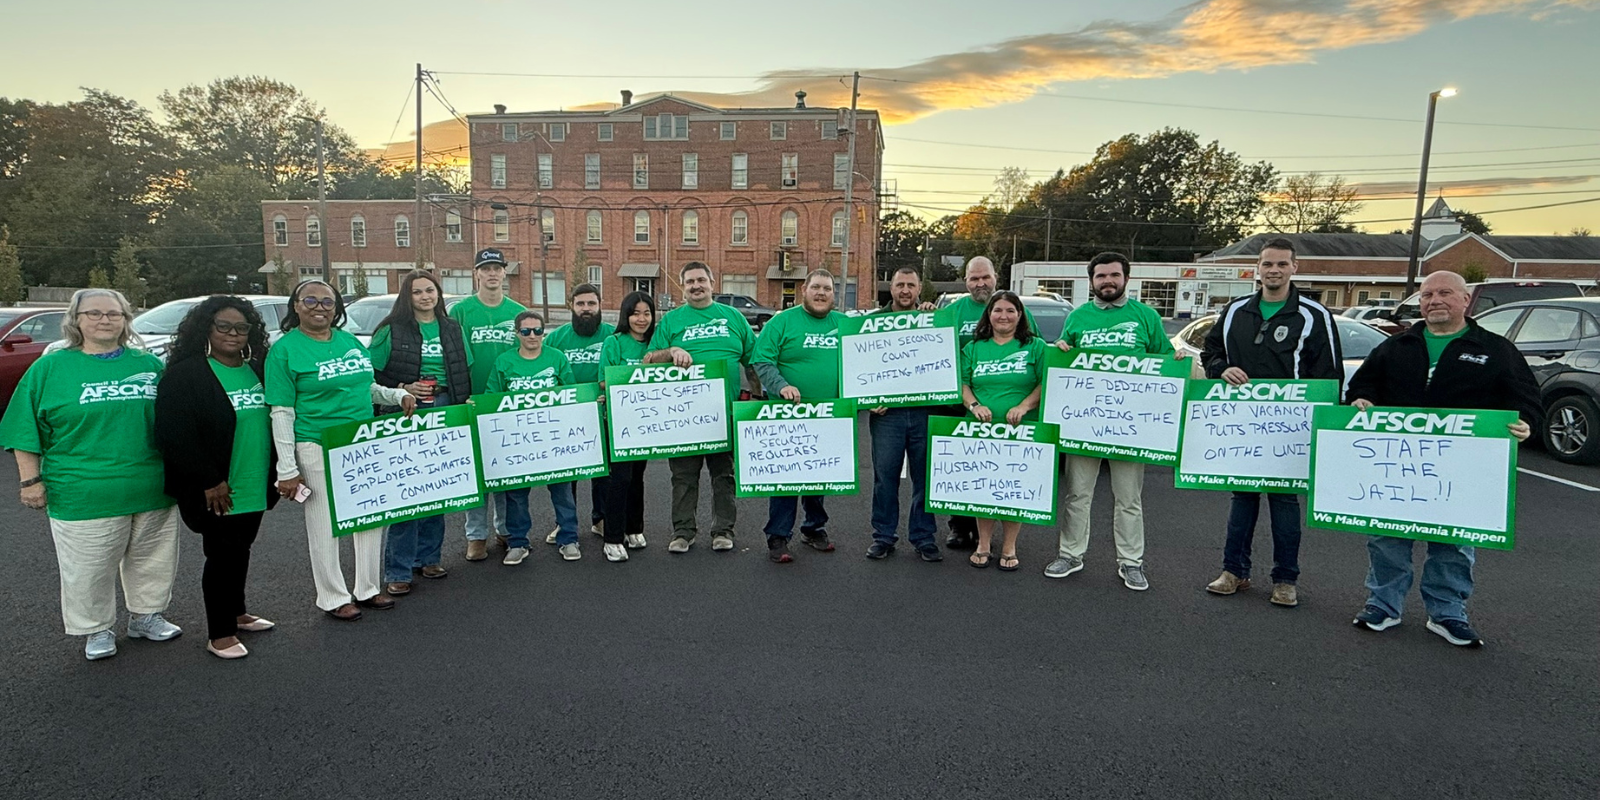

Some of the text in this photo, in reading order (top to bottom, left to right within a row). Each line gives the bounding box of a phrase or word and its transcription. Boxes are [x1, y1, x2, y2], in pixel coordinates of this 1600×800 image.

[683, 325, 729, 338] AFSCME
[859, 313, 934, 333] AFSCME
[471, 330, 516, 340] AFSCME
[854, 333, 943, 353] WHEN SECONDS
[1080, 332, 1137, 344] AFSCME
[882, 349, 918, 363] COUNT
[1070, 353, 1164, 374] AFSCME
[318, 358, 372, 377] AFSCME
[628, 364, 705, 383] AFSCME
[857, 359, 951, 385] STAFFING MATTERS
[974, 361, 1026, 373] AFSCME
[80, 384, 157, 400] AFSCME
[508, 377, 555, 390] AFSCME
[1059, 376, 1178, 394] THE DEDICATED
[1204, 383, 1307, 401] AFSCME
[497, 388, 577, 411] AFSCME
[617, 383, 711, 406] PUBLIC SAFETY
[880, 394, 926, 403] Pennsylvania
[1095, 395, 1124, 405] FEW
[635, 401, 693, 418] IS NOT
[756, 403, 834, 419] AFSCME
[1062, 406, 1174, 424] GUARDING THE
[1191, 403, 1309, 421] EVERY VACANCY
[352, 411, 446, 443] AFSCME
[490, 410, 560, 433] I FEEL
[621, 413, 719, 438] A SKELETON CREW
[952, 421, 1036, 440] AFSCME
[1205, 420, 1313, 436] PUTS PRESSUR
[1345, 411, 1476, 435] AFSCME
[502, 426, 586, 447] LIKE I AM
[744, 423, 807, 440] MAXIMUM
[1092, 425, 1137, 437] WALLS
[342, 430, 466, 468] MAKE THE JAIL
[492, 434, 597, 466] A SINGLE PARENT!
[630, 448, 649, 456] Make
[652, 444, 697, 454] Pennsylvania
[760, 434, 818, 448] SECURITY
[937, 440, 1043, 460] I WANT MY
[1352, 438, 1452, 458] STAFF
[748, 445, 818, 461] REQUIRES
[1082, 443, 1138, 456] Pennsylvania
[1139, 450, 1176, 461] Happen
[1205, 448, 1225, 460] ON
[1229, 445, 1263, 457] THE
[343, 445, 451, 482] SAFE FOR THE
[749, 457, 840, 476] MAXIMUM STAFF
[934, 461, 1028, 476] HUSBAND TO
[1374, 463, 1438, 478] THE
[485, 466, 604, 488] We Make Pennsylvania Happen
[935, 478, 1021, 493] MAKE IT HOME
[1180, 475, 1196, 483] We
[1199, 476, 1224, 484] Make
[1227, 477, 1289, 488] Pennsylvania
[357, 472, 470, 510] THE COMMUNITY
[740, 485, 753, 493] We
[776, 484, 823, 492] Pennsylvania
[338, 497, 479, 530] We Make Pennsylvania Happen
[944, 502, 965, 511] Make
[967, 505, 1017, 516] Pennsylvania
[1019, 510, 1051, 520] Happen
[1313, 513, 1506, 543] We Make Pennsylvania Happen
